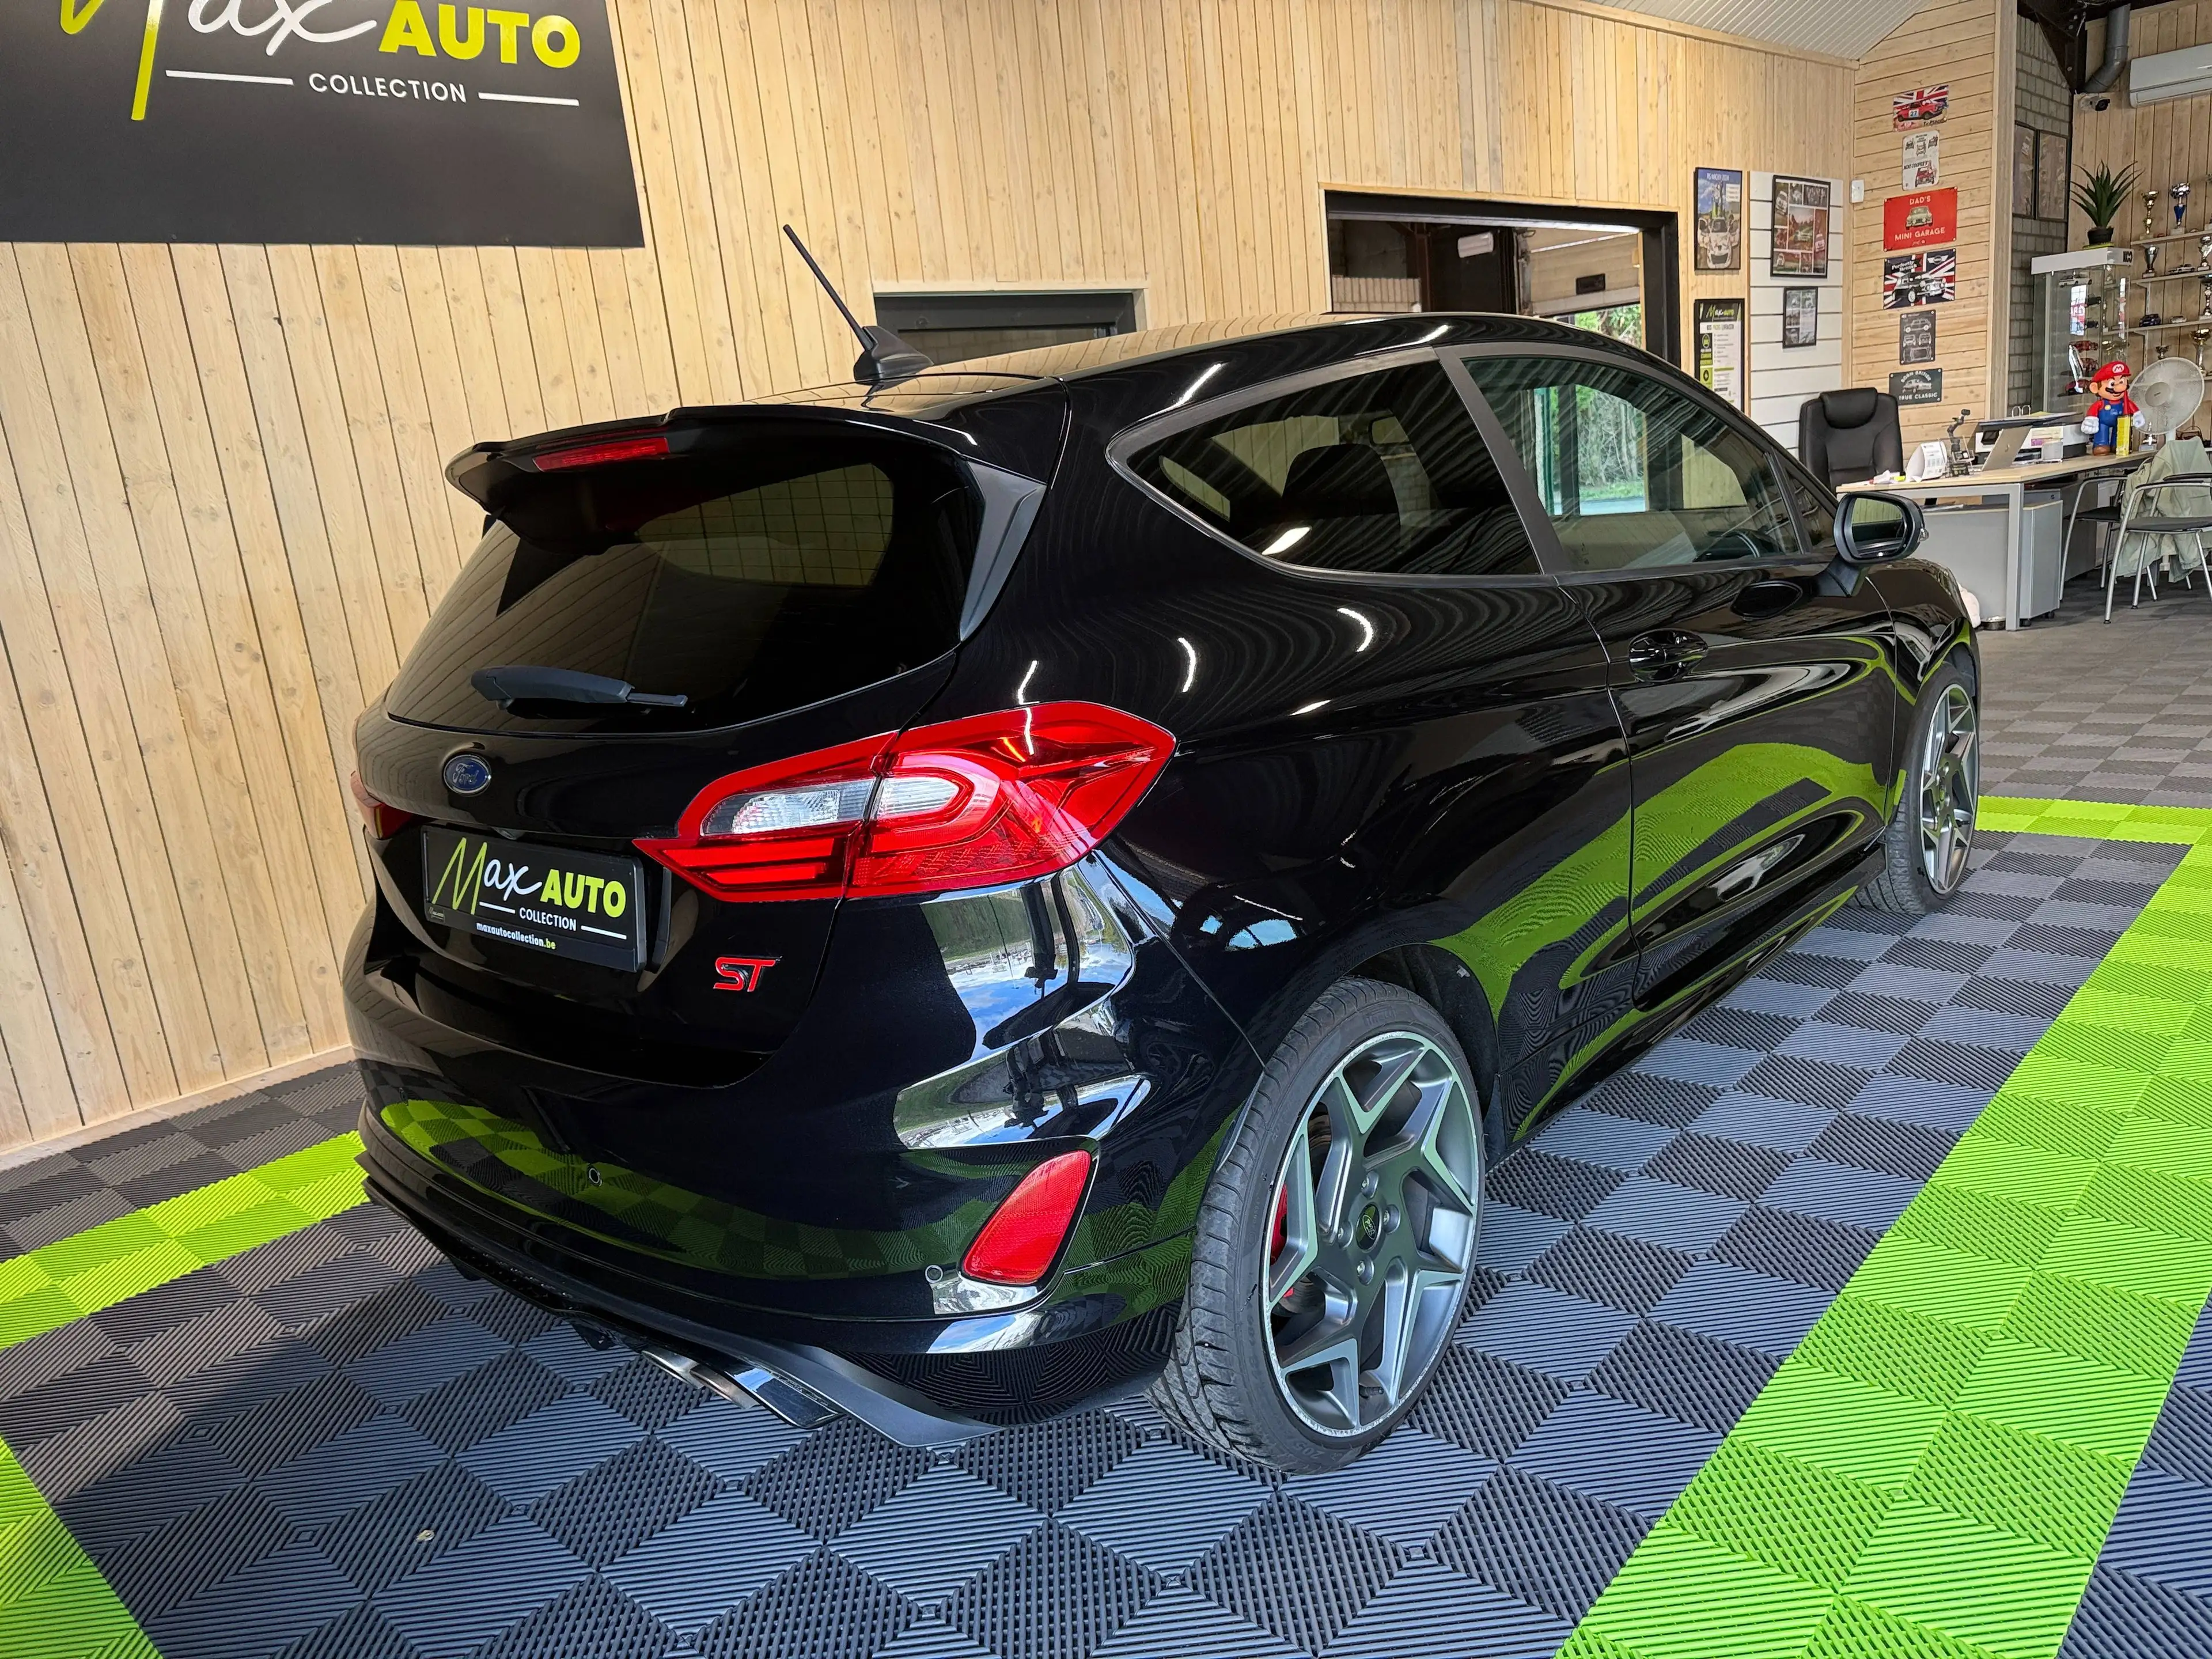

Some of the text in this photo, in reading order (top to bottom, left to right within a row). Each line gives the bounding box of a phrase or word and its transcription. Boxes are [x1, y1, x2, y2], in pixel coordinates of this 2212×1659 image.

[379, 0, 581, 69] AUTO
[309, 73, 467, 104] COLLECTION
[1909, 195, 1931, 205] DAD'S
[1895, 227, 1945, 241] MINI GARAGE
[1900, 372, 1914, 382] BORN
[1914, 392, 1938, 400] CLASSIC
[452, 763, 479, 785] Ford
[433, 838, 626, 918] Max AUTO
[519, 907, 577, 931] COLLECTION
[476, 922, 556, 950] maxautocollection.be
[713, 956, 779, 992] ST
